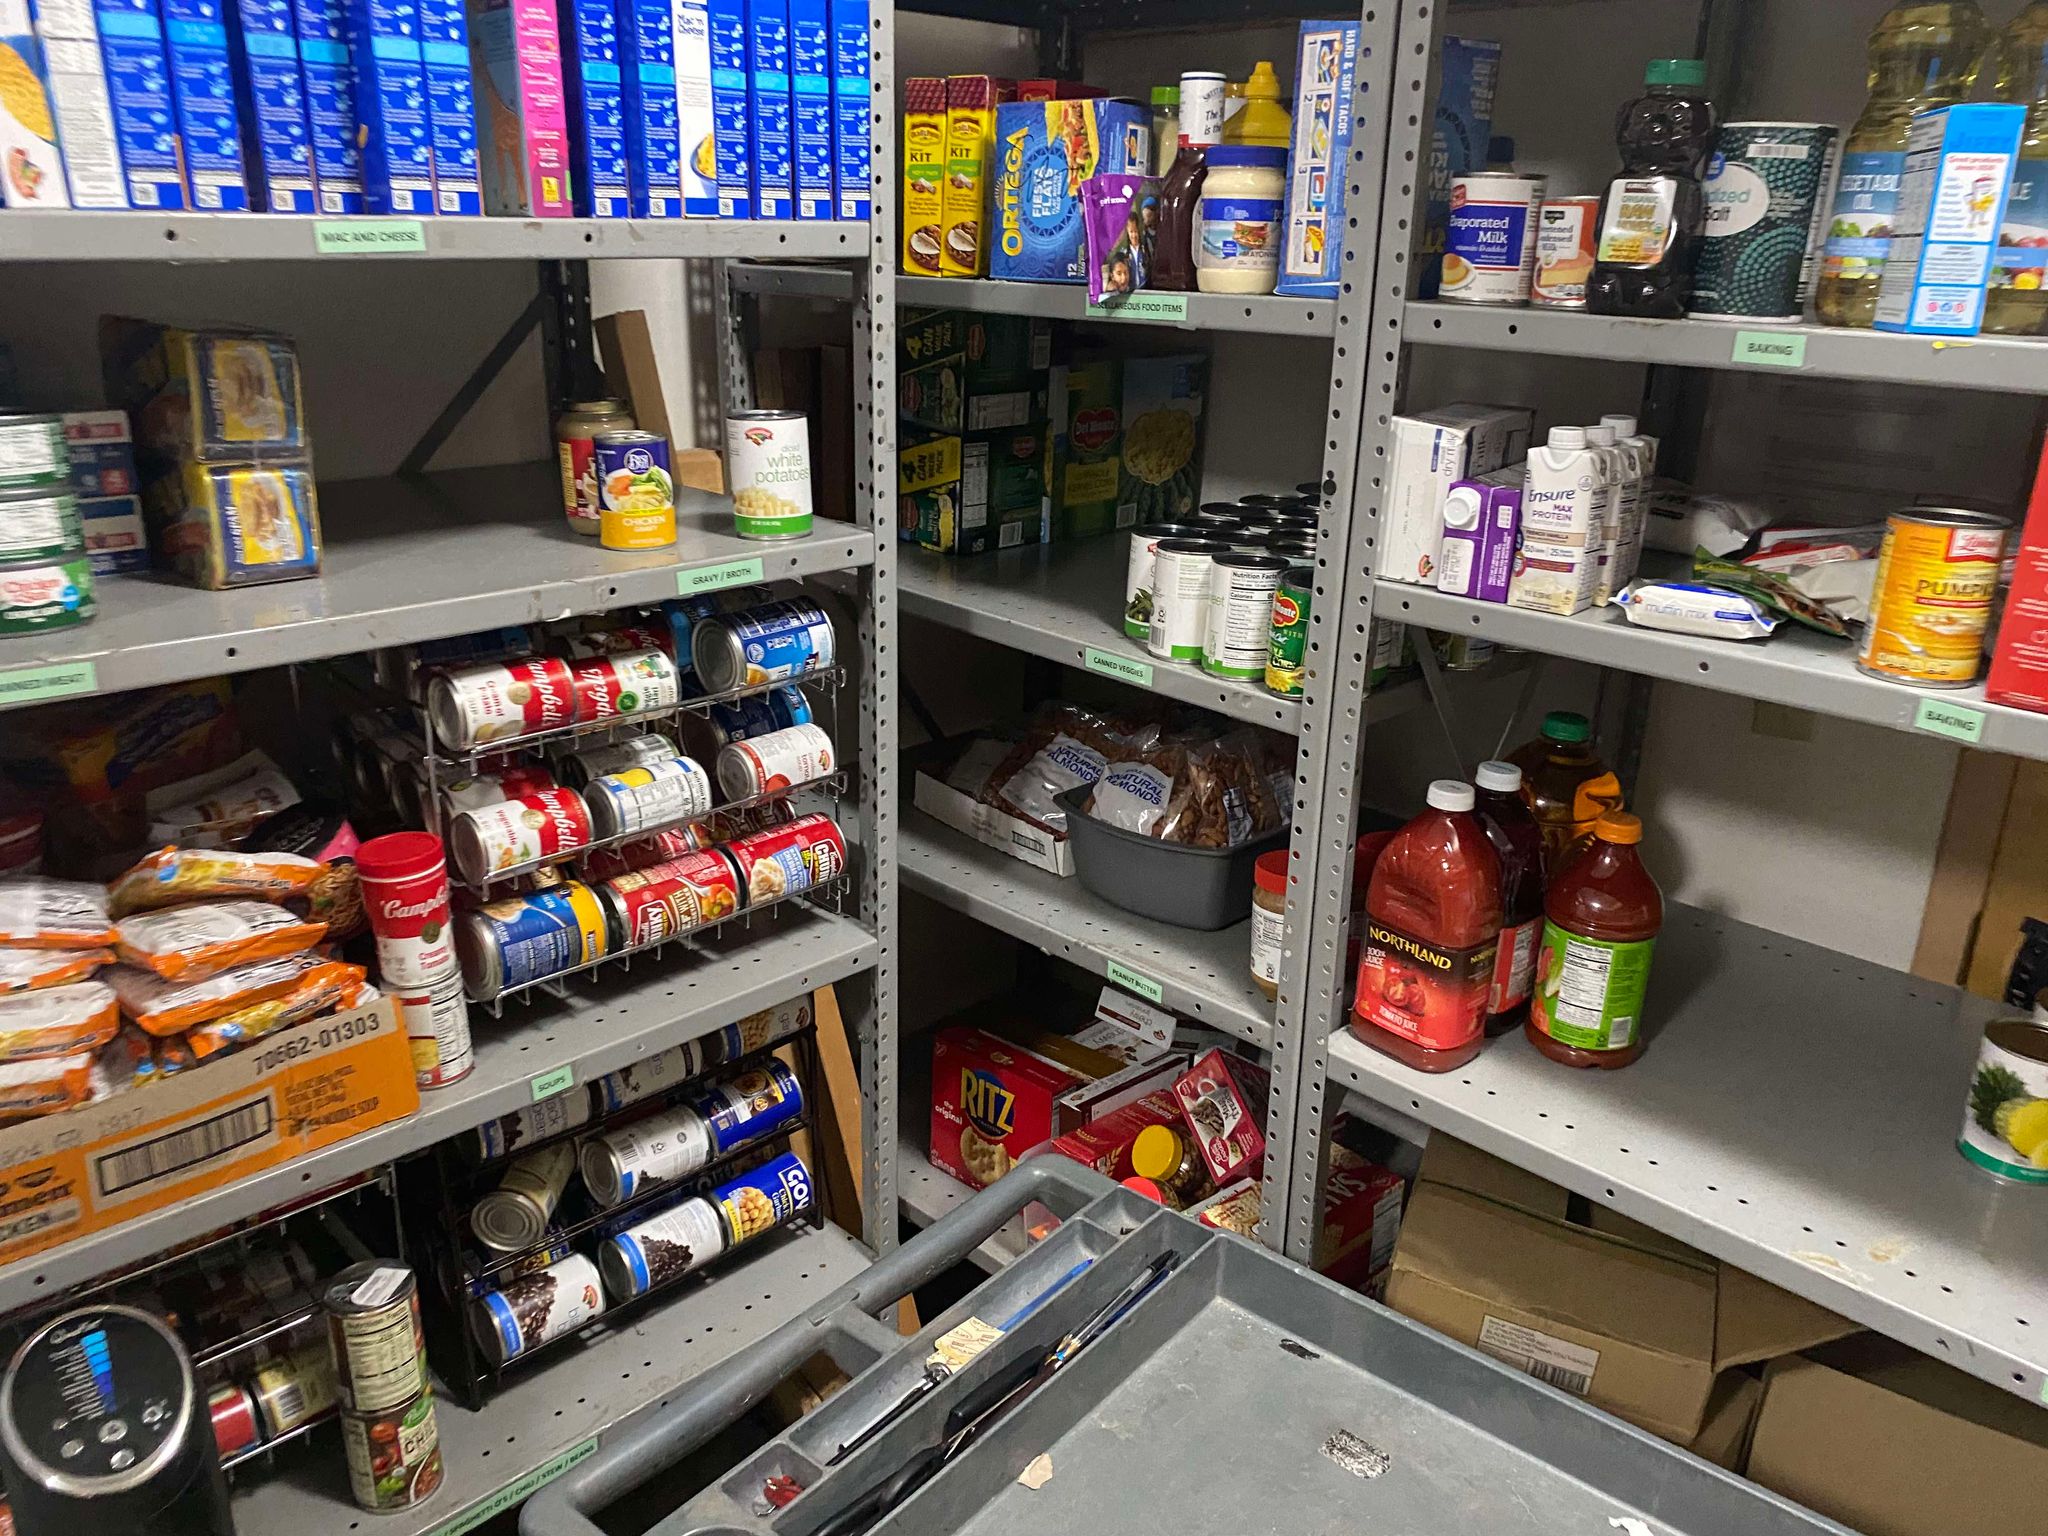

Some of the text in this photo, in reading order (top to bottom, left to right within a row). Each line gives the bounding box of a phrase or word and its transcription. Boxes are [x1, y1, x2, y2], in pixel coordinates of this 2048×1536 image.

[1345, 30, 1356, 55] HARD
[1341, 73, 1353, 99] SOFT
[1205, 110, 1219, 121] The
[1337, 101, 1350, 136] TACOS
[909, 152, 932, 163] KIT
[950, 147, 971, 158] KIT
[1001, 126, 1029, 257] ORTEGA
[1032, 166, 1043, 218] FIESTA
[1042, 167, 1055, 216] FLATS
[379, 230, 419, 242] CHEESE
[1477, 231, 1508, 244] Milk
[1067, 263, 1078, 278] 12
[1141, 302, 1162, 312] FOOD
[1162, 303, 1183, 313] ITEMS
[1747, 342, 1794, 356] BAKING
[765, 453, 804, 468] white
[755, 467, 810, 486] potatoes
[1528, 489, 1576, 503] Ensure
[1531, 510, 1573, 522] PROTEIN
[1552, 503, 1574, 513] MAX
[622, 515, 666, 527] CHICKEN
[692, 573, 719, 586] GRAVY
[726, 567, 752, 581] BROTH
[1232, 571, 1260, 580] Nutrition
[1093, 656, 1144, 678] CANNED VEGGIES
[1925, 710, 1976, 732] BAKING
[1046, 750, 1101, 783] ALMONDS
[1056, 746, 1103, 777] NATURAL
[1369, 925, 1452, 970] NORTHLAND
[1111, 967, 1159, 997] PEANUT BUTTER
[537, 1075, 566, 1093] SOUPS
[960, 1066, 1016, 1134] RITZ
[934, 1105, 963, 1126] original
[786, 1169, 809, 1211] GOY
[569, 1444, 595, 1463] BEANS
